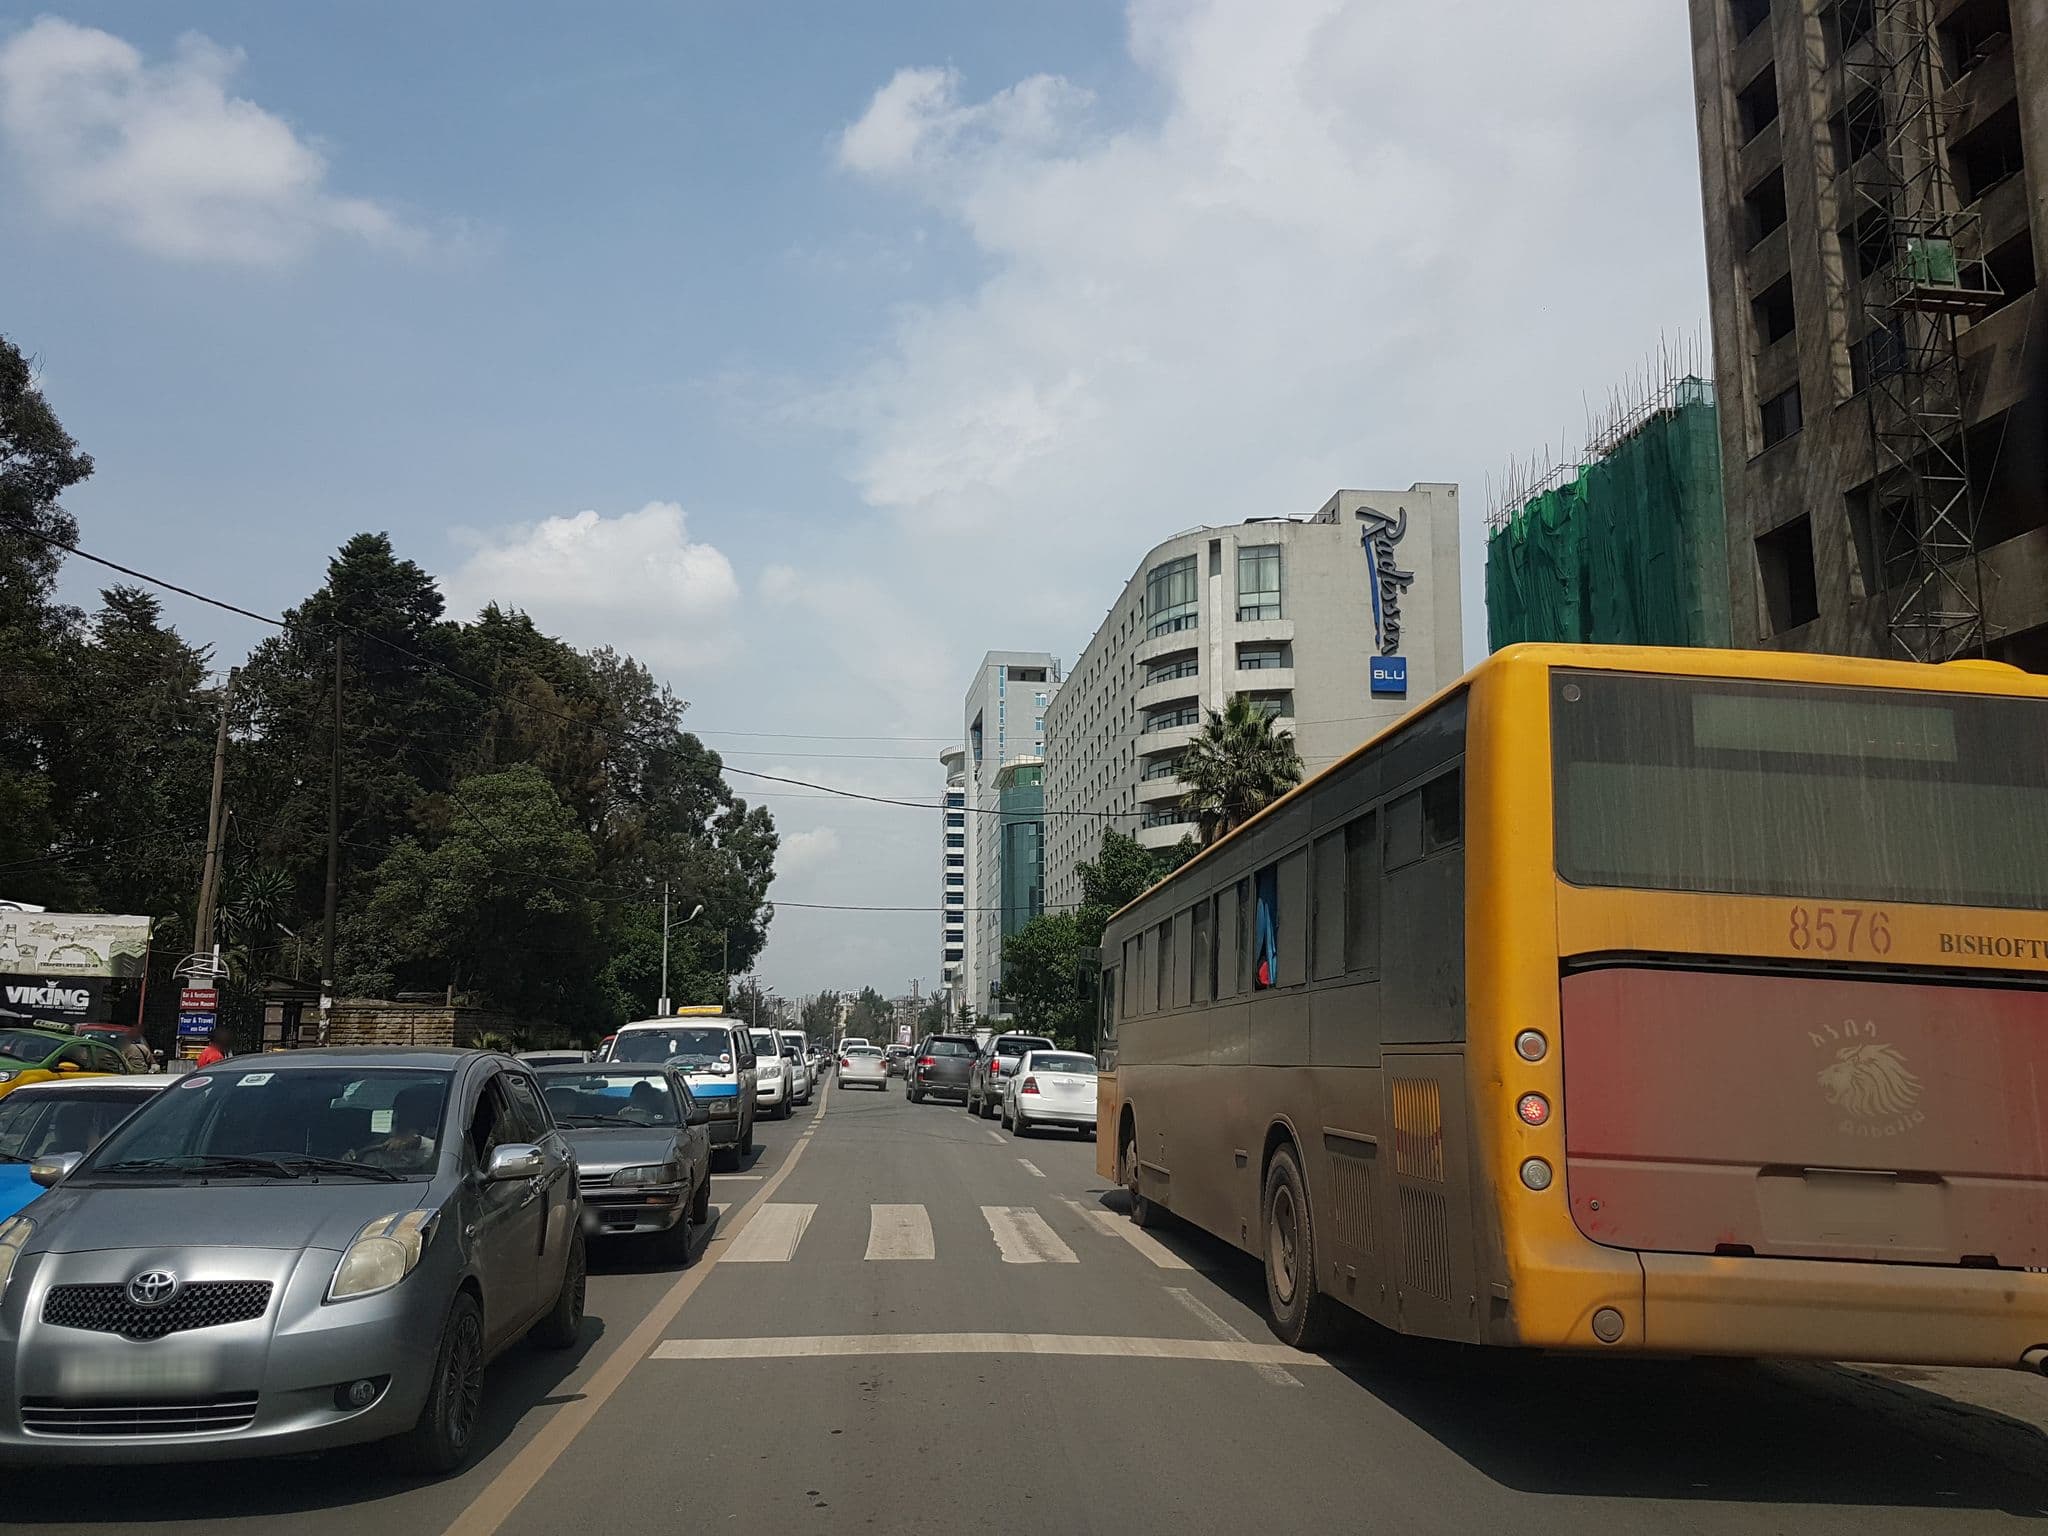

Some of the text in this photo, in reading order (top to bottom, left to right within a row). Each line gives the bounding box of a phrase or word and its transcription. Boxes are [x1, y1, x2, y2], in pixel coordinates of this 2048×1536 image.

[1356, 506, 1414, 656] Radisson
[1374, 669, 1405, 680] BLU
[1789, 905, 1892, 955] 8576
[5, 985, 90, 1007] VIKING
